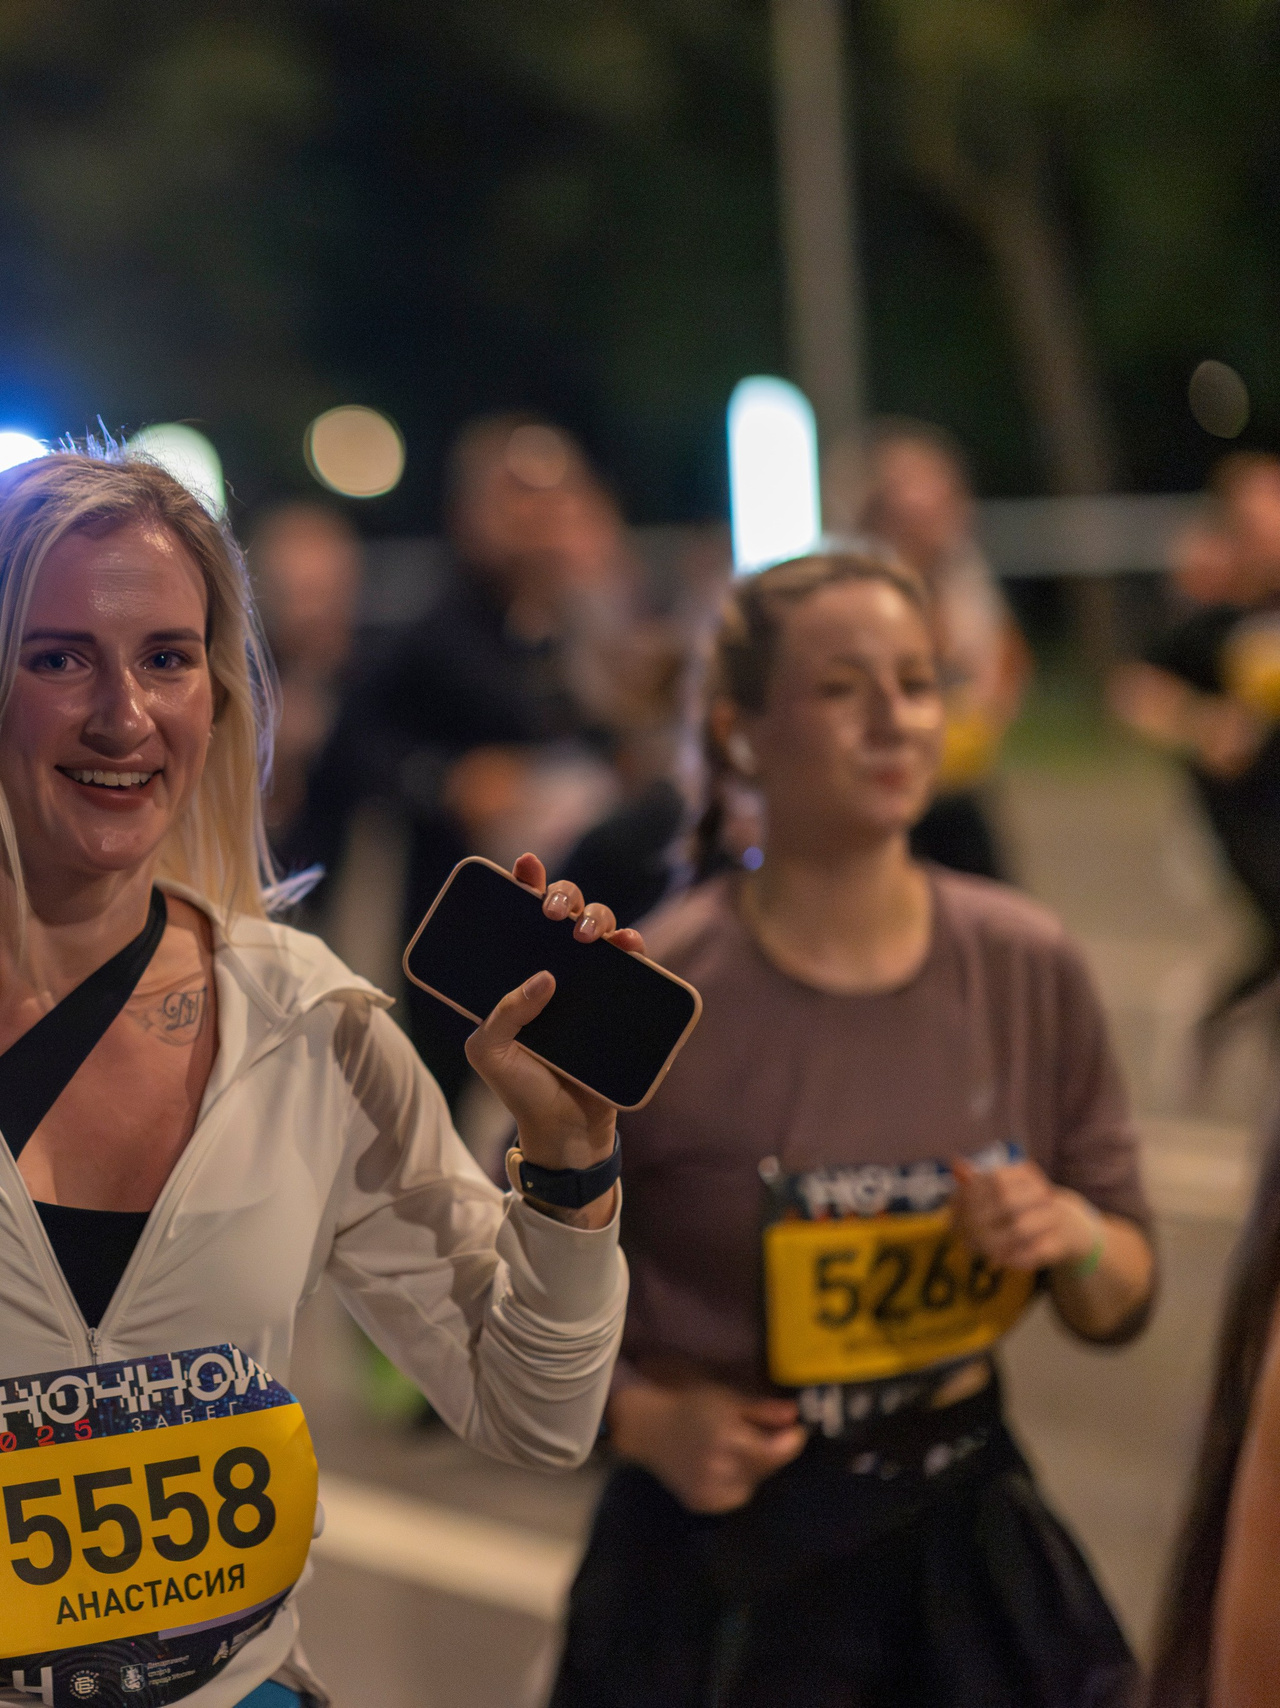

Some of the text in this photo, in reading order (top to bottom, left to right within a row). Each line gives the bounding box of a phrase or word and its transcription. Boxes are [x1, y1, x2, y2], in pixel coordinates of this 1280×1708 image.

[131, 1401, 238, 1433] ЗАБЕГ
[2, 1446, 277, 1586] 5558
[56, 1563, 245, 1625] АНАСТАСИЯ
